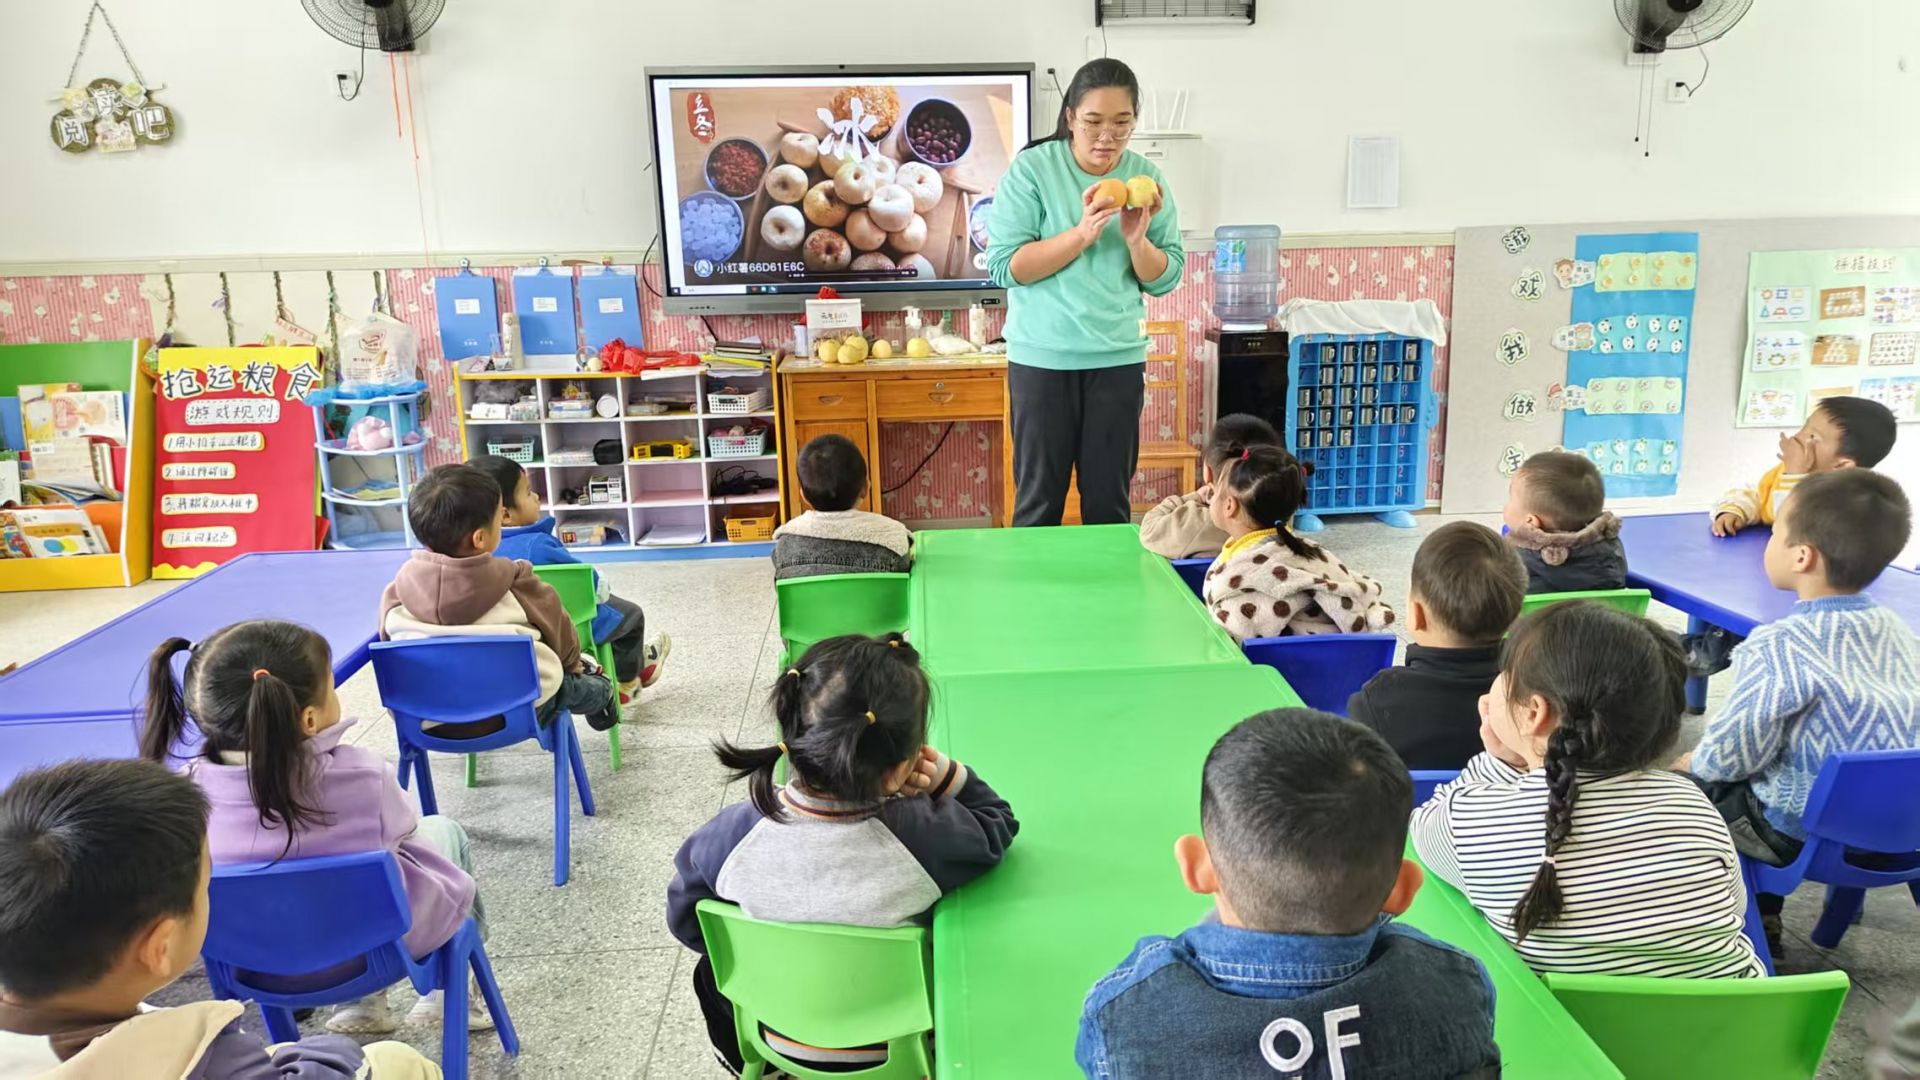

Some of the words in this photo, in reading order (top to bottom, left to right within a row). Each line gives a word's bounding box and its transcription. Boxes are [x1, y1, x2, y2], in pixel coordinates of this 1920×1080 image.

[56, 86, 170, 149] 阅读吧
[692, 93, 713, 136] 立冬
[816, 96, 880, 161] 冰
[716, 262, 805, 274] 小红薯66D61E6C
[163, 361, 321, 399] 抢运粮食
[190, 405, 274, 419] 游戏规则
